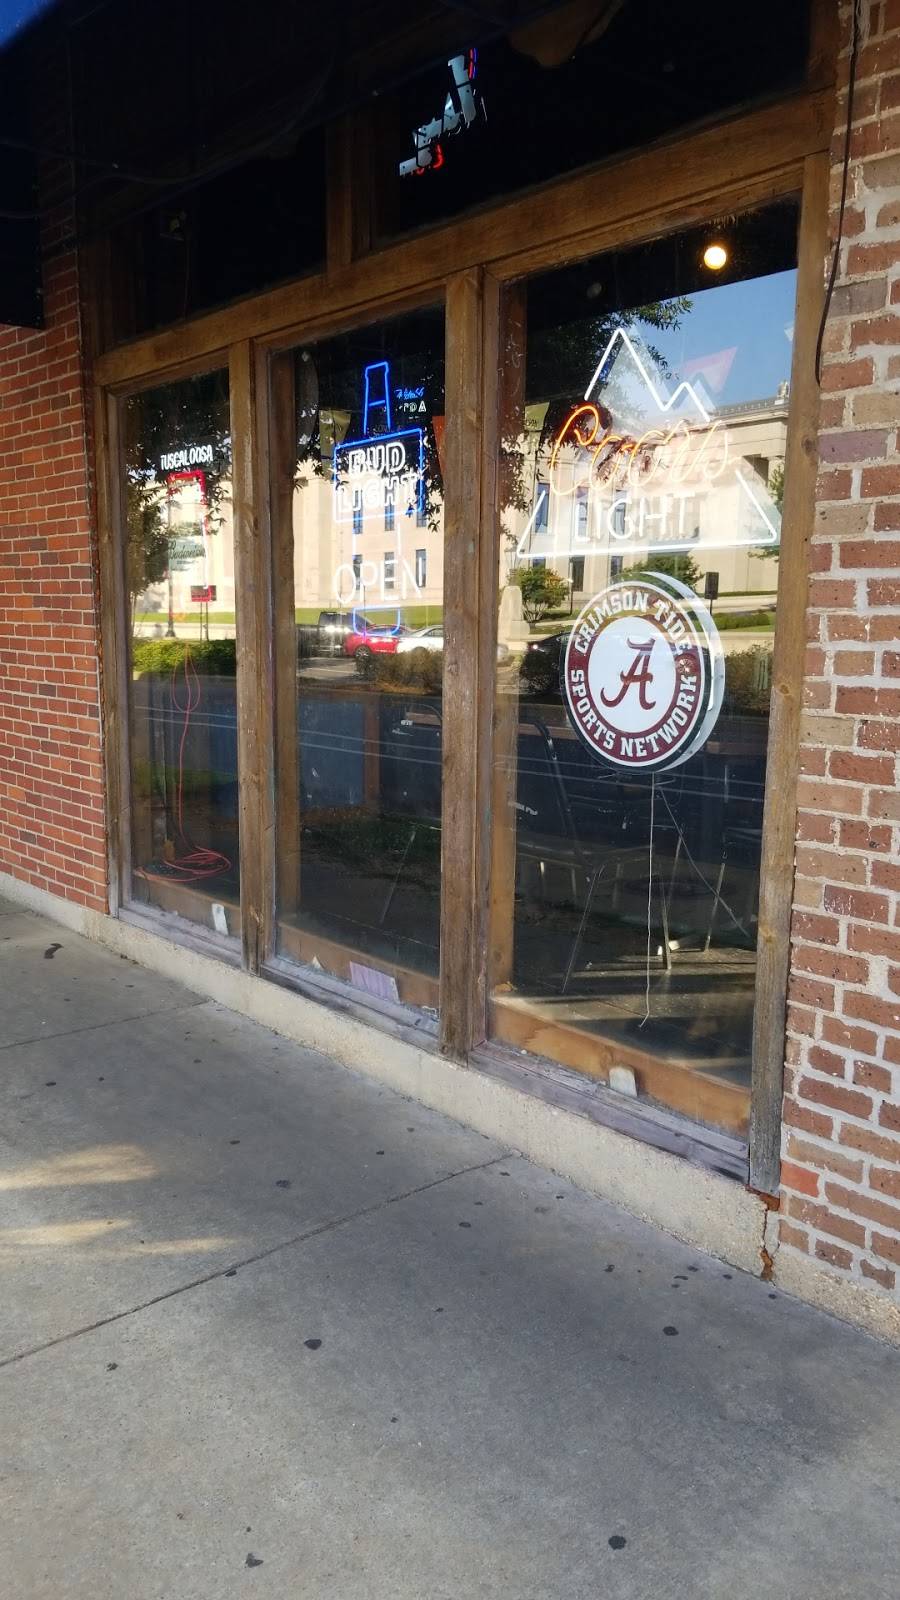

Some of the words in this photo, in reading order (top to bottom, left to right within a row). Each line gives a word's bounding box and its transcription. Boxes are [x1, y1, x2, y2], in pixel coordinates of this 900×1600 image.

[160, 444, 214, 471] TUSCALOOSA
[347, 440, 407, 475] BUD
[549, 404, 736, 496] Coors
[335, 473, 420, 513] LIGHT
[574, 490, 696, 542] LIGHT
[333, 557, 424, 605] OPEN
[574, 591, 650, 655] CRIMSON
[653, 599, 693, 656] TIDE
[570, 669, 617, 750] SPORTS
[619, 674, 698, 758] NETWORK
